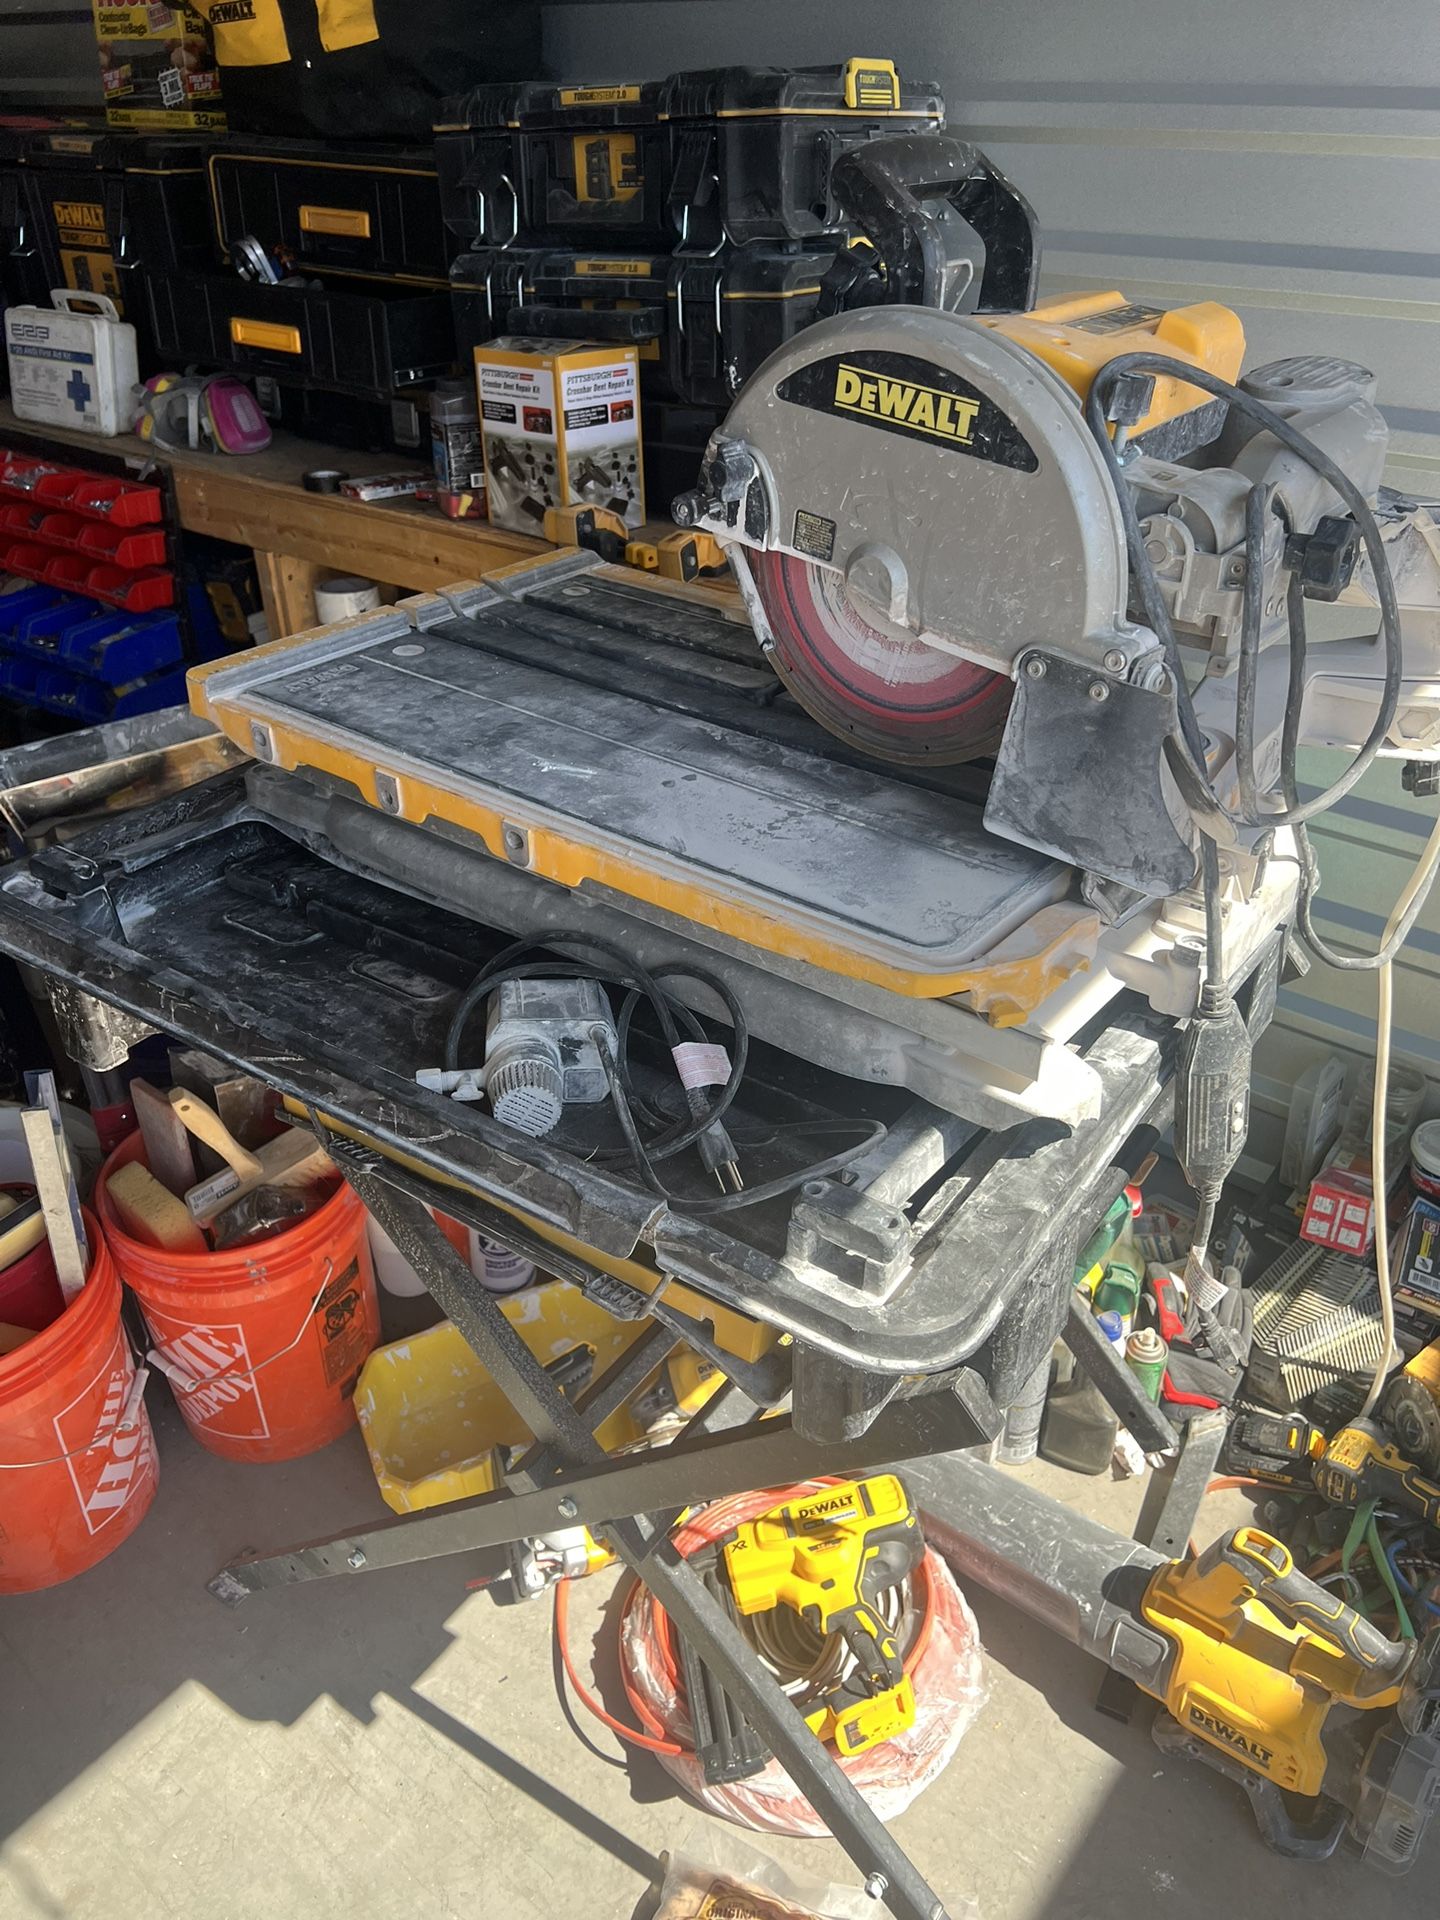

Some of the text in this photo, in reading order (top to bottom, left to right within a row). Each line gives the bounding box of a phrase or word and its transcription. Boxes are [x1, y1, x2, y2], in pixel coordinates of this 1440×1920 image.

[208, 1, 256, 23] DEWALT
[616, 90, 627, 99] 2.0
[194, 113, 209, 126] 32
[55, 203, 105, 227] DEWALT
[566, 370, 612, 385] PITTSBURGH
[532, 385, 540, 394] Kit
[593, 384, 607, 393] Dent
[608, 381, 626, 391] Repair
[626, 378, 634, 387] Kit
[835, 368, 979, 439] DEWALT
[799, 1495, 853, 1519] DEWALT
[732, 1540, 748, 1553] XR
[1190, 1706, 1273, 1763] DEWALT
